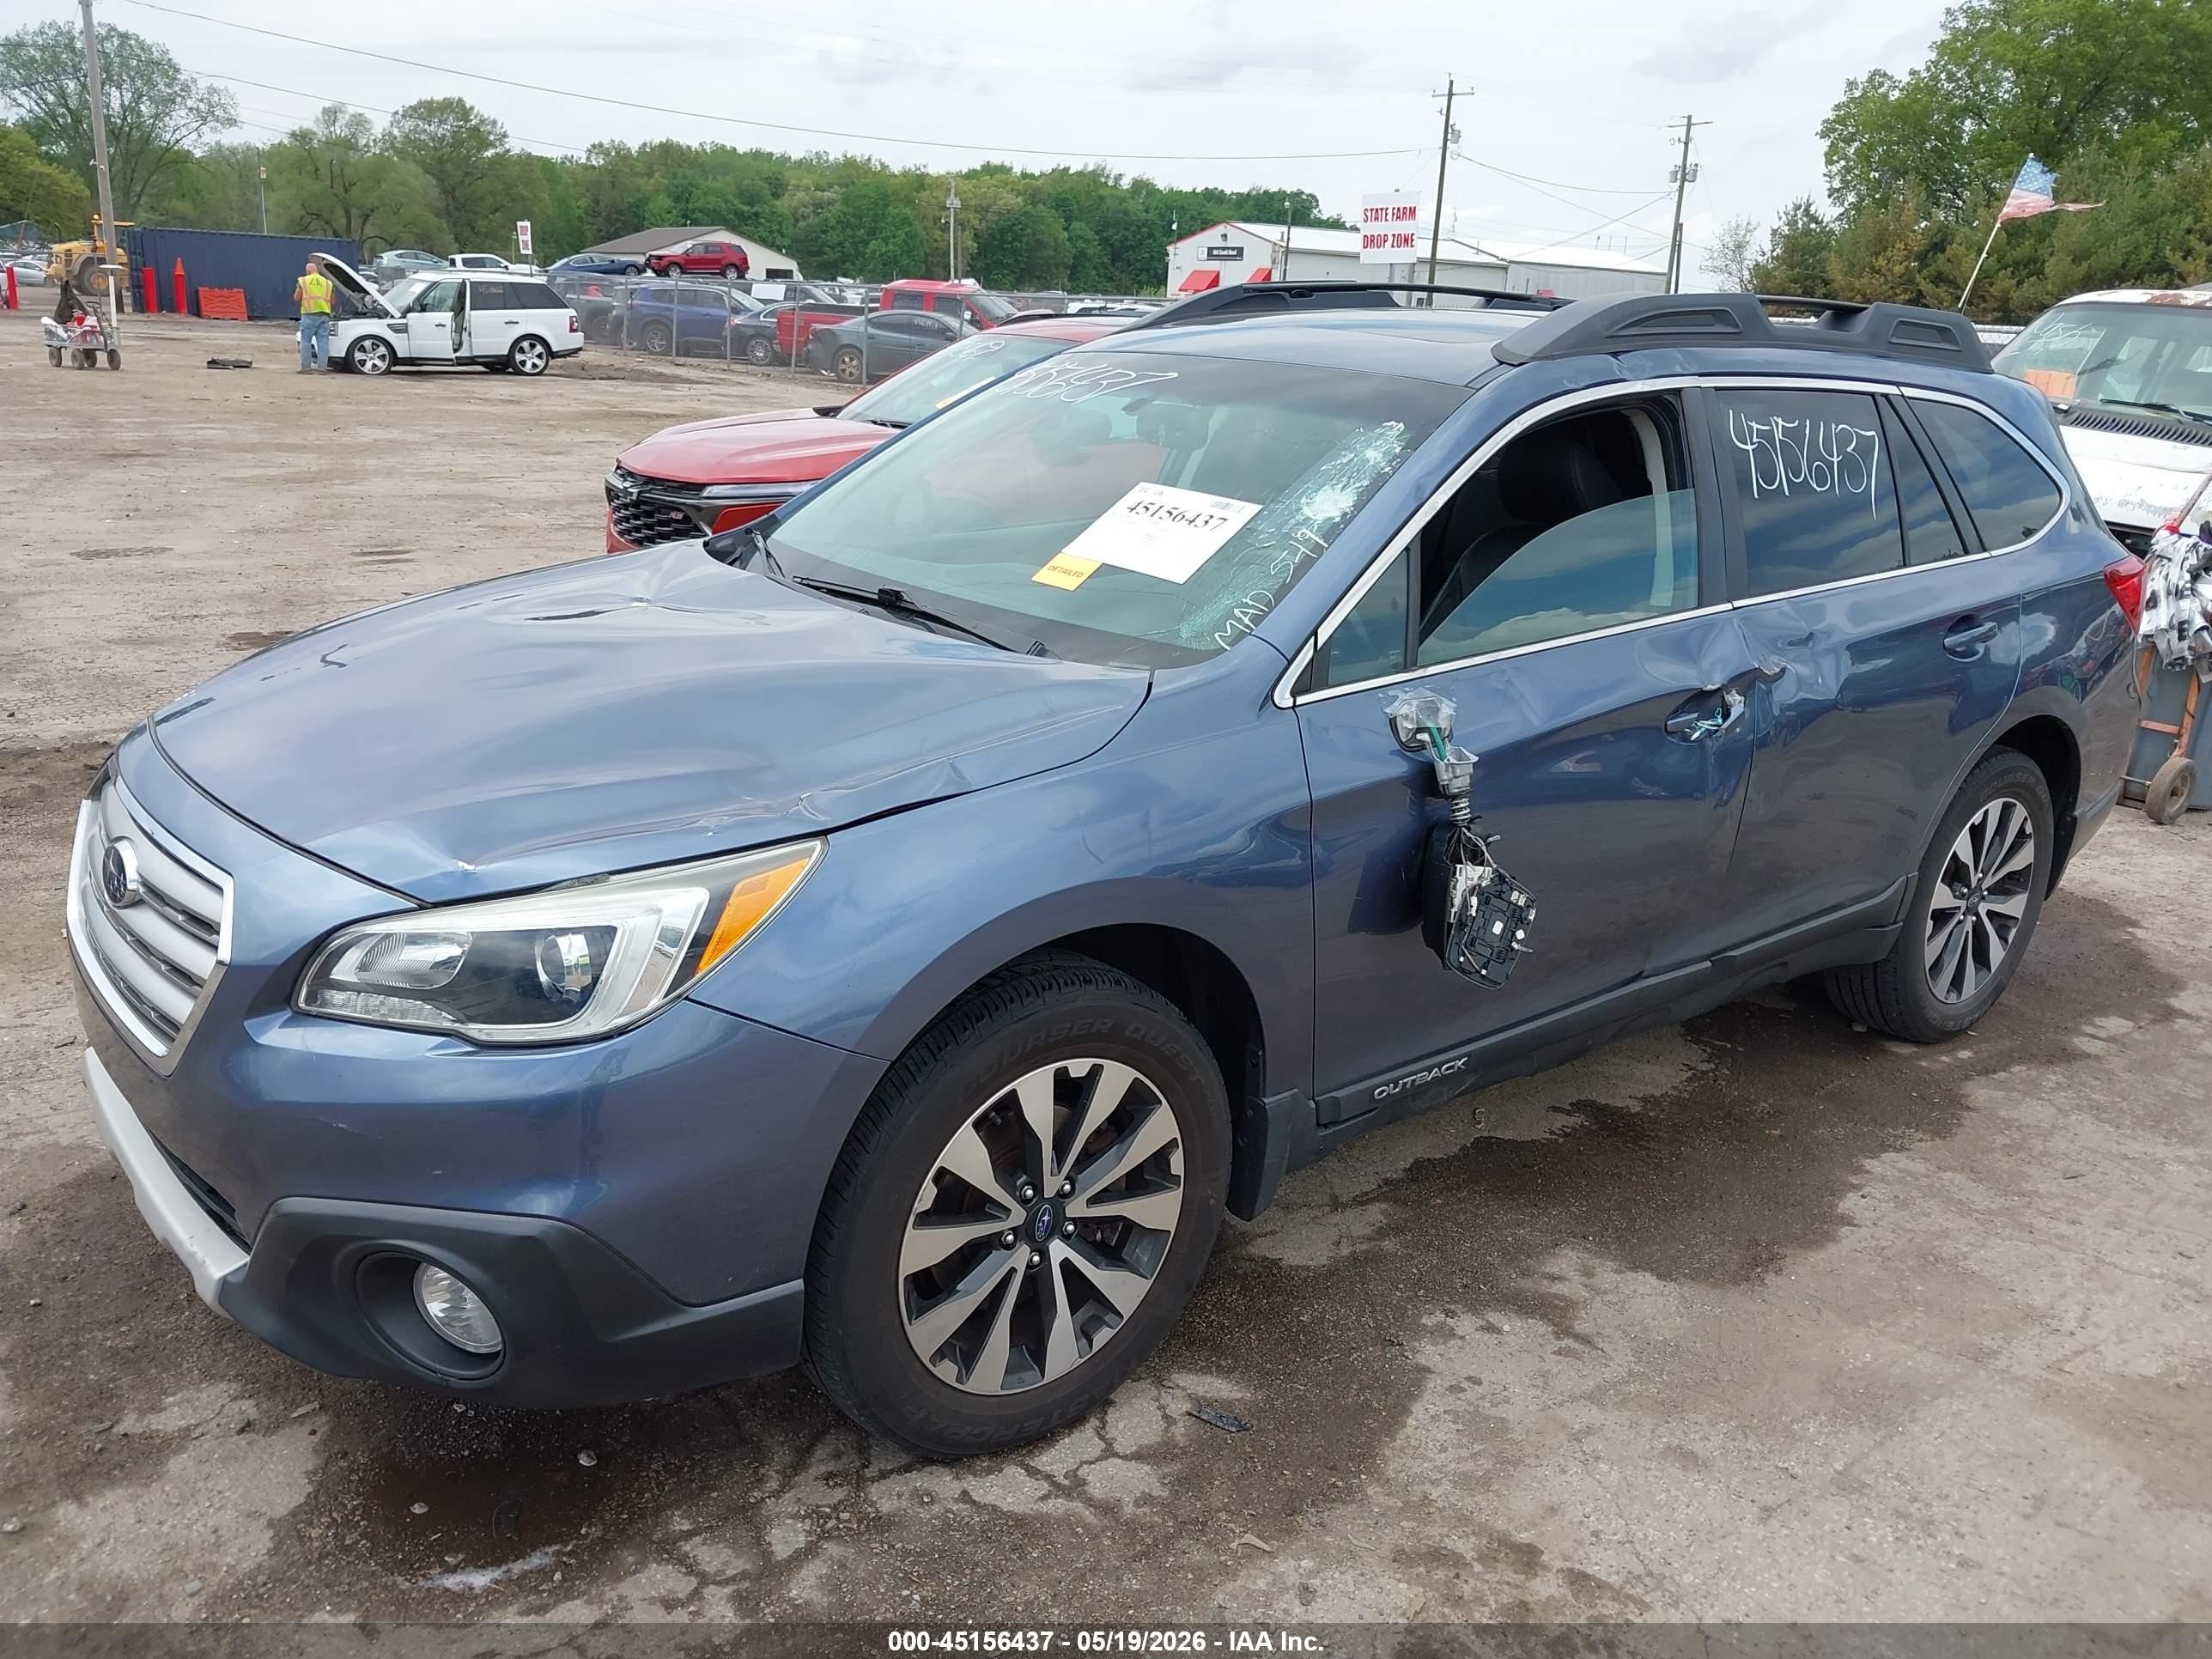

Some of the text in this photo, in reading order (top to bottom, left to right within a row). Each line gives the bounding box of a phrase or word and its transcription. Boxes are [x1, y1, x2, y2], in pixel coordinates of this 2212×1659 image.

[1364, 206, 1416, 223] STATE FARM
[1363, 233, 1415, 249] DROP ZONE
[1729, 409, 1880, 520] 45156437
[1127, 500, 1230, 532] 45156437
[1047, 564, 1085, 580] DETAILED
[1214, 590, 1275, 650] MAD
[1374, 1056, 1468, 1099] OUTBACK
